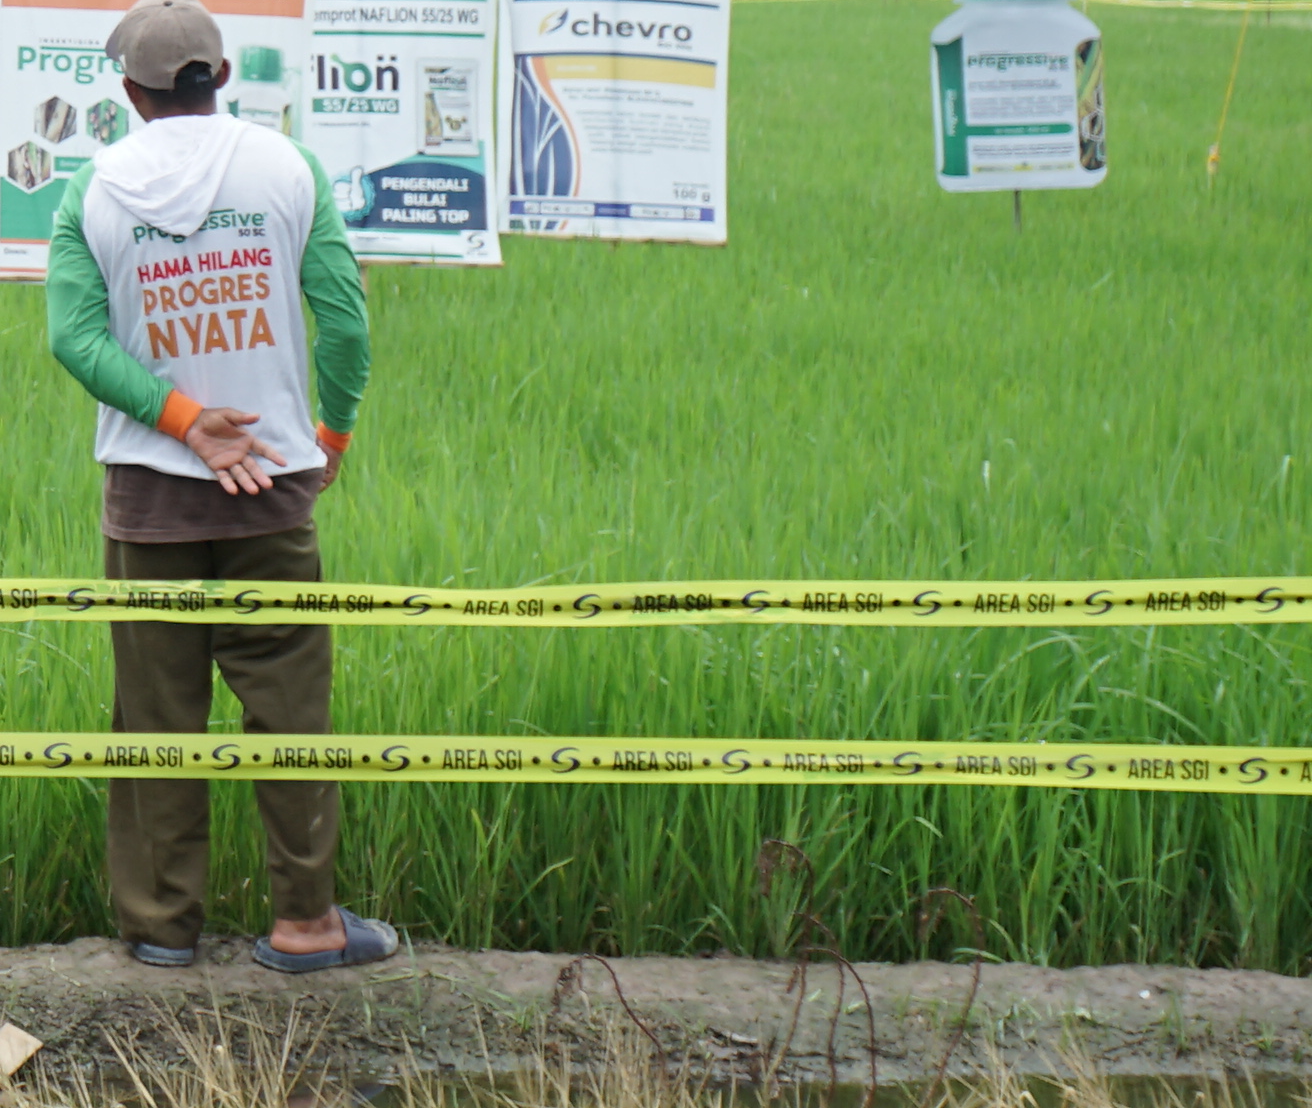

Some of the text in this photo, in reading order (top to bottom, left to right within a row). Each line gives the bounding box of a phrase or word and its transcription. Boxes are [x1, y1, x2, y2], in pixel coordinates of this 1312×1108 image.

[359, 7, 418, 23] NAFLION
[458, 9, 479, 25] WG
[571, 12, 693, 42] chevro
[372, 100, 398, 113] WG
[381, 177, 469, 192] PENGENDALI
[403, 193, 448, 207] BULAI
[382, 208, 470, 224] PALING TOP
[237, 227, 266, 238] 50 SC
[137, 248, 273, 284] HAMA HILANG
[142, 272, 271, 317] PROGRES
[146, 307, 276, 360] NYATA
[9, 587, 38, 609] SGI
[126, 590, 173, 611] AREA
[176, 591, 205, 612] SGI
[292, 593, 339, 613] AREA
[345, 594, 374, 614] SGI
[463, 598, 509, 617] AREA
[514, 598, 544, 618] SGI
[632, 594, 680, 613] AREA
[684, 593, 713, 612] SGI
[802, 594, 850, 613] AREA
[855, 593, 883, 613] SGI
[974, 594, 1021, 613] AREA
[1026, 593, 1056, 613] SGI
[1145, 592, 1193, 612] AREA
[1197, 591, 1226, 611] SGI
[104, 746, 149, 768] AREA
[155, 746, 184, 769] SGI
[272, 747, 319, 768] AREA
[323, 747, 353, 769] SGI
[442, 749, 489, 771] AREA
[493, 749, 522, 771] SGI
[612, 750, 658, 772] AREA
[663, 751, 693, 772] SGI
[783, 752, 830, 773] AREA
[834, 753, 864, 774] SGI
[955, 755, 1002, 775] AREA
[1007, 755, 1037, 777] SGI
[1127, 758, 1175, 780] AREA
[1180, 760, 1209, 781] SGI
